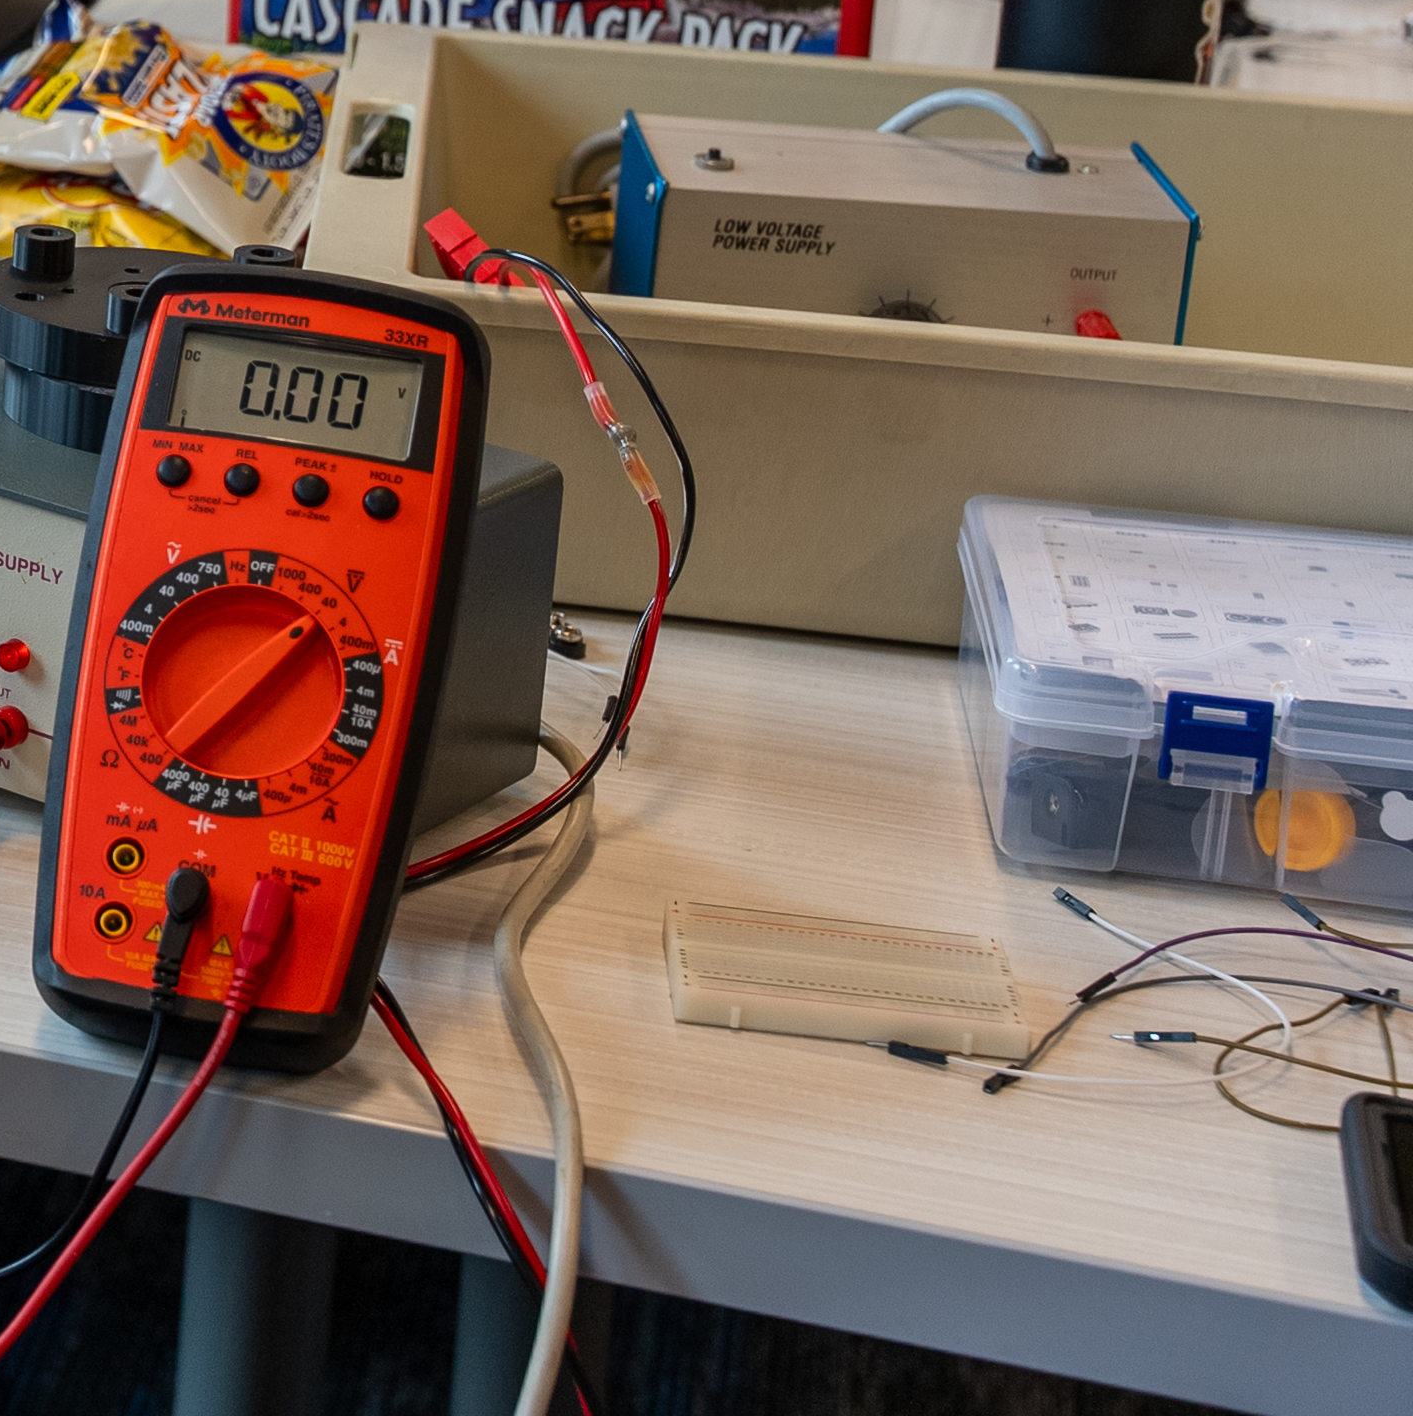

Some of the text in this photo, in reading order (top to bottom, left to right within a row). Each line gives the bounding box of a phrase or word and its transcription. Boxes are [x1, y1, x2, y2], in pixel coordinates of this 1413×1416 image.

[714, 219, 826, 239] LOW VOLTAGE
[712, 235, 837, 256] POWER SUPPLY
[1069, 267, 1118, 282] OUTPUT
[214, 302, 311, 329] Meterman
[383, 328, 429, 349] 33XR
[184, 349, 202, 363] DC
[239, 359, 369, 431] 0.00
[398, 387, 407, 399] V
[152, 439, 205, 454] MIN MAX
[236, 448, 258, 461] REL
[294, 457, 327, 472] PEAK
[369, 470, 404, 485] HOLD
[187, 494, 222, 505] cancel
[197, 561, 222, 575] 750
[230, 561, 246, 573] Hz
[250, 561, 275, 574] OFF
[277, 567, 307, 581] 1000
[176, 571, 200, 585] 400
[159, 585, 176, 597] 40
[298, 582, 322, 595] 400
[144, 603, 153, 615] 4
[321, 597, 337, 609] 40
[119, 619, 154, 634] 400m
[356, 686, 375, 698] 4m
[350, 717, 374, 730] 10A
[336, 733, 368, 749] 300m
[100, 749, 120, 768] Ω
[140, 752, 163, 765] 400
[162, 768, 190, 782] 4000
[188, 781, 210, 793] 400
[214, 787, 230, 798] 40
[268, 830, 298, 845] CAT
[316, 840, 356, 858] 1000V
[269, 843, 299, 857] CAT
[290, 870, 321, 887] Temp
